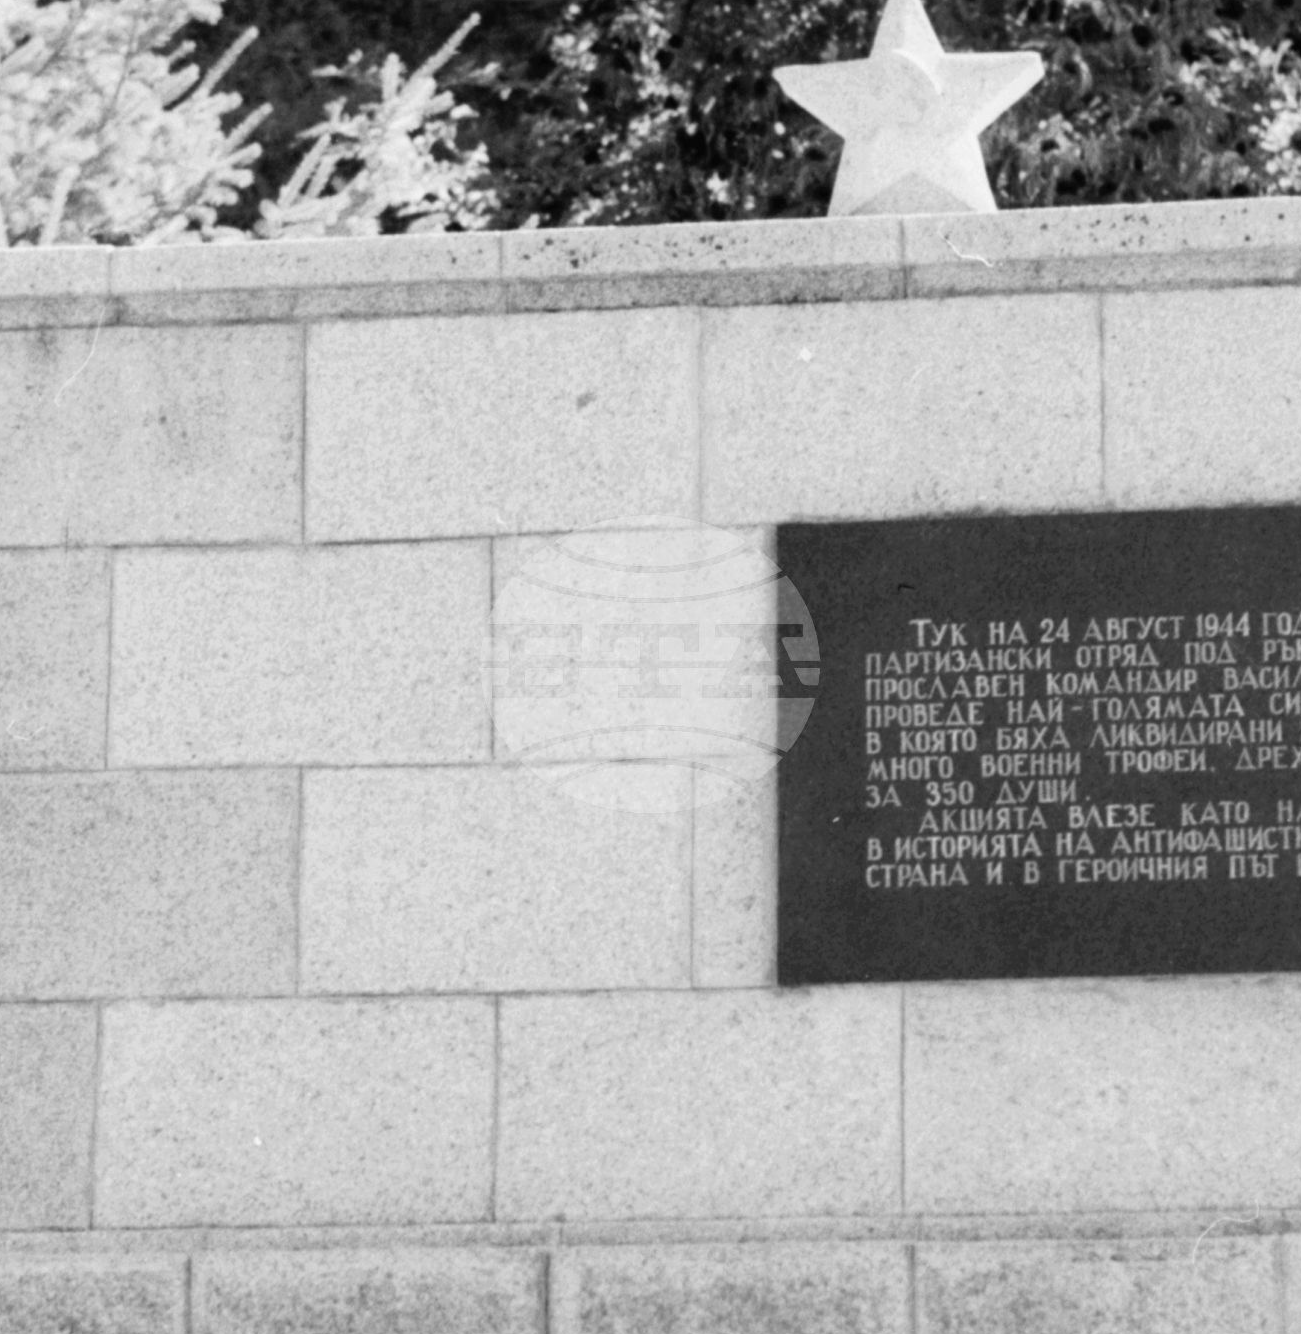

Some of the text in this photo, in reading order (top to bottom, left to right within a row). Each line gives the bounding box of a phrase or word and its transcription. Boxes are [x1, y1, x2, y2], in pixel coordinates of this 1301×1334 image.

[908, 617, 968, 648] ТУК
[987, 621, 1029, 646] НА
[1039, 618, 1071, 644] 24
[1083, 616, 1185, 642] АВГУСТ
[1195, 611, 1251, 638] 1944
[865, 647, 1052, 675] ПАРТИЗАНСКИ
[1074, 643, 1161, 668] ОТРЯД
[1183, 639, 1237, 665] ПОД
[864, 674, 1026, 701] ПРОСЛАВЕН
[1045, 668, 1199, 697] КОМАНДИР
[865, 701, 984, 729] ПРОВЕДЕ
[1268, 692, 1301, 716] СИ
[865, 731, 882, 755] В
[899, 726, 978, 753] КОЯТО
[995, 725, 1071, 751] БЯХА
[1089, 719, 1284, 748] ЛИКВИДИРАНИ
[867, 756, 955, 782] МНОГО
[980, 752, 1082, 778] ВОЕННИ
[865, 779, 1092, 808] ЗА 350 ДУШИ.
[918, 806, 1048, 833] АКЦИЯТА
[1067, 803, 1156, 829] ВЛЕЗЕ
[1180, 801, 1251, 827] КАТО
[866, 837, 884, 861] В
[893, 832, 1044, 862] ИСТОРИЯТА
[1055, 831, 1096, 856] НА
[864, 862, 969, 888] СТРАНА
[985, 861, 1004, 885] И
[1023, 861, 1041, 884] В
[1057, 855, 1209, 883] ГЕРОИЧНИЯ
[1228, 853, 1279, 879] ПЪТ
